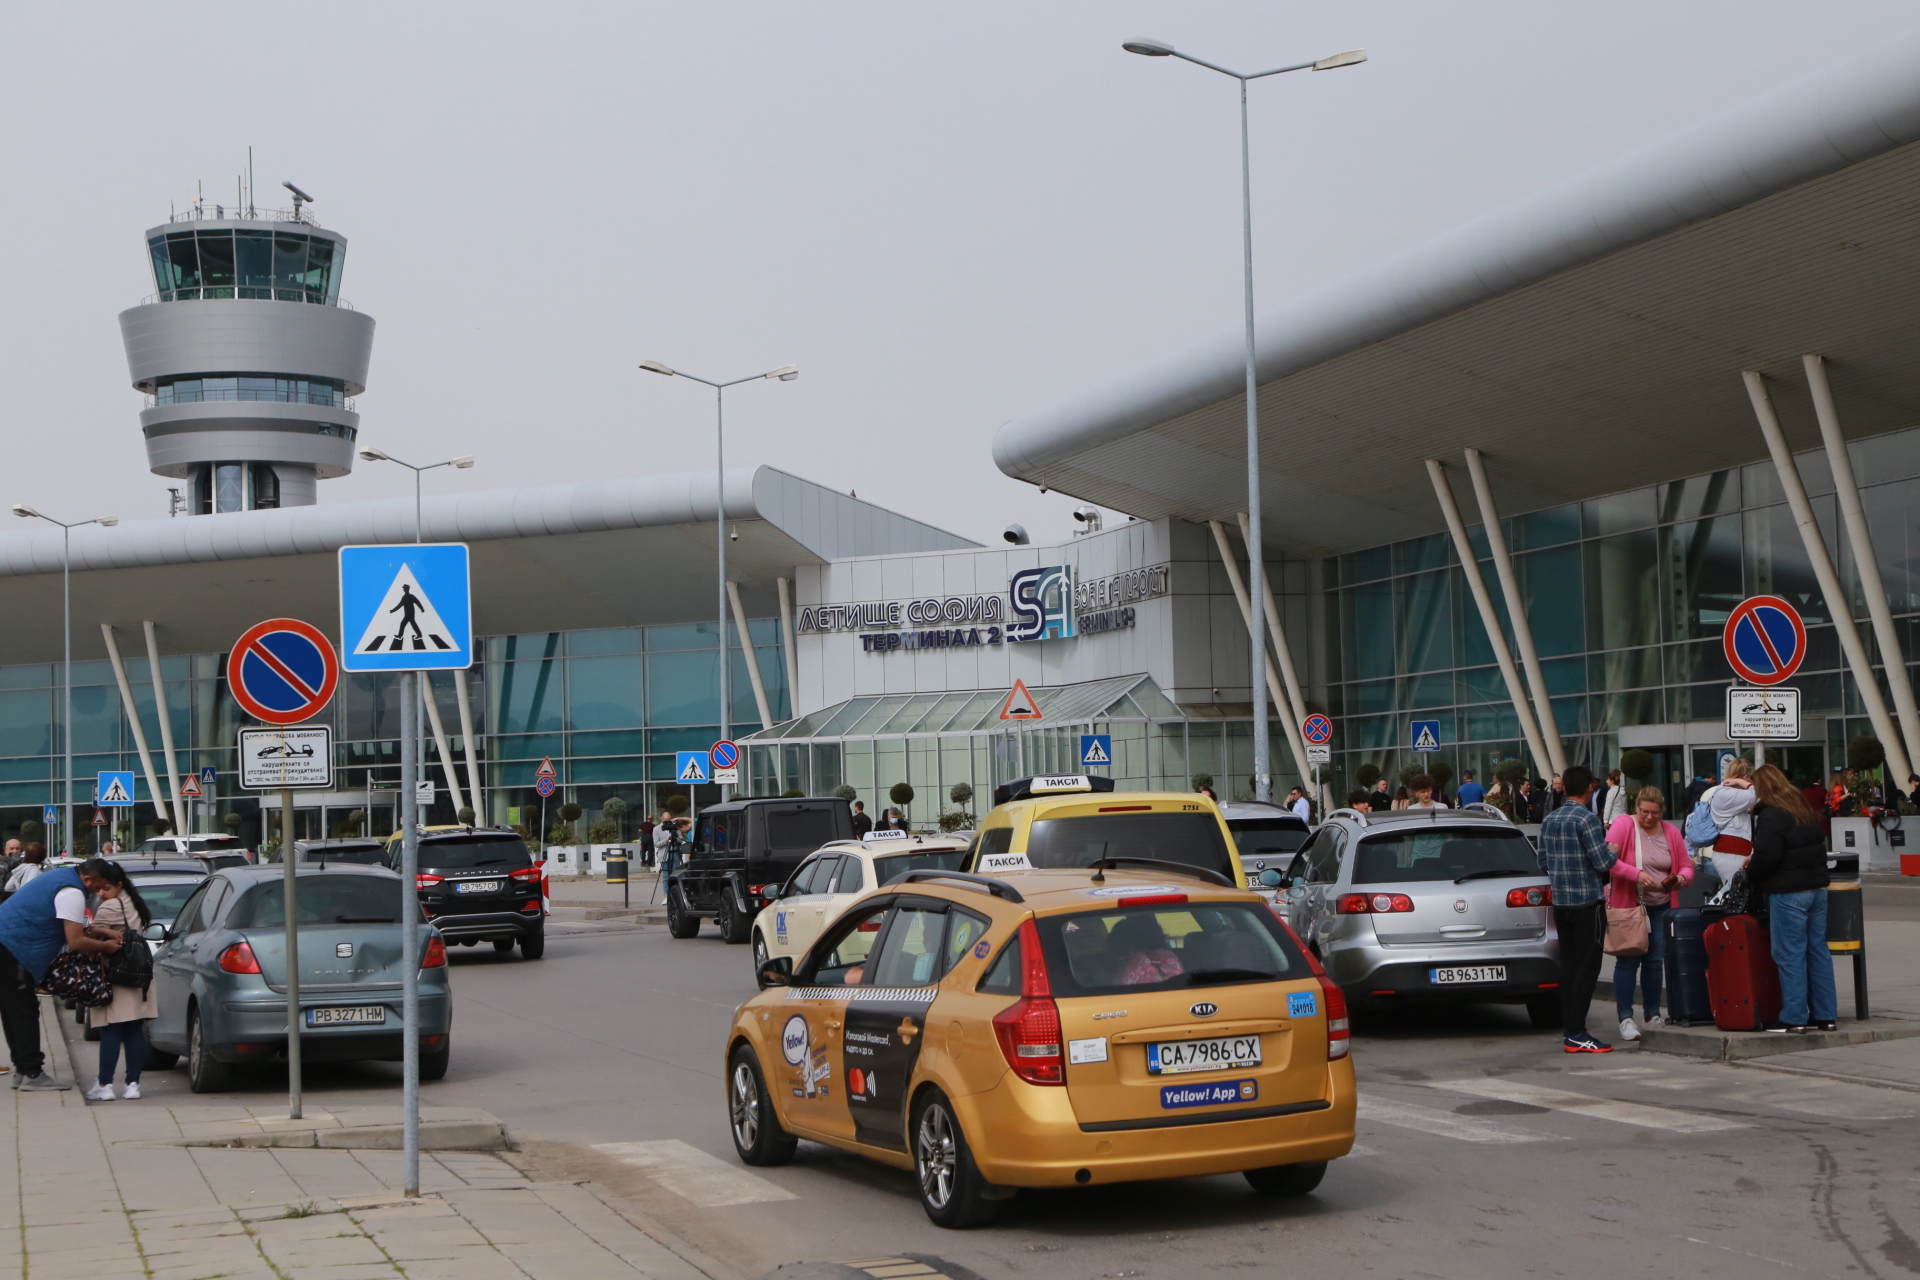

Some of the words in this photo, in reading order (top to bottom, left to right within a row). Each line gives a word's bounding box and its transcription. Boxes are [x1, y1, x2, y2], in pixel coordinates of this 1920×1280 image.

[1112, 566, 1165, 602] AIRPORT
[798, 601, 900, 631] ЛЕТИЩЕ
[907, 595, 1004, 624] СОФИЯ
[1078, 608, 1121, 634] ERMINAL
[859, 627, 981, 652] ТЕРМИНАЛ
[987, 626, 1002, 645] 2
[1044, 778, 1079, 787] ТАКСИ
[872, 830, 901, 838] ТАКСИ
[987, 856, 1024, 867] ТАКСИ
[1438, 969, 1455, 982] CB
[1456, 968, 1485, 981] 9631
[1488, 967, 1505, 979] TM
[315, 1009, 332, 1022] PB
[334, 1008, 363, 1021] 3271
[366, 1007, 383, 1020] HM
[1193, 1004, 1215, 1015] KIA
[785, 1030, 805, 1050] Yellow!
[1160, 1045, 1184, 1066] CA
[1187, 1040, 1231, 1064] 7986
[1234, 1039, 1258, 1059] CX
[1165, 1089, 1209, 1103] Yellow!
[1212, 1087, 1236, 1101] App
